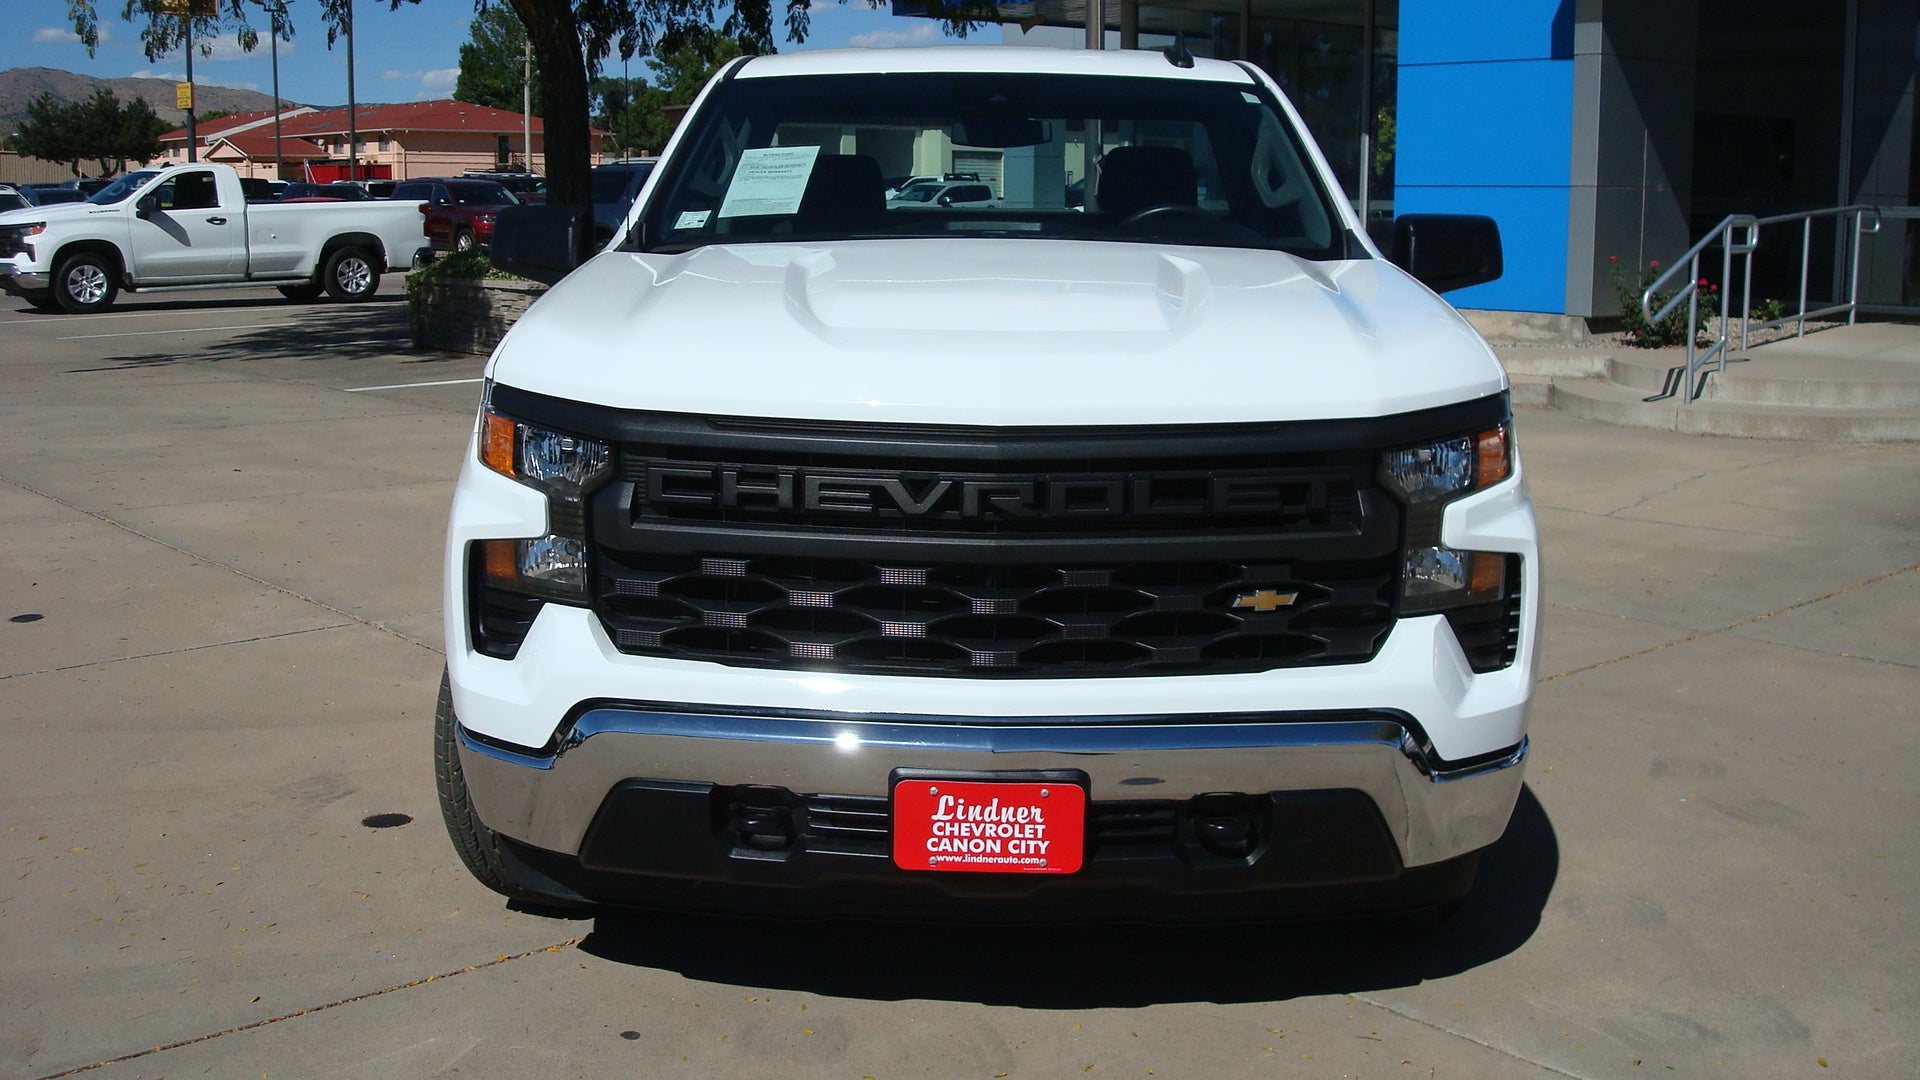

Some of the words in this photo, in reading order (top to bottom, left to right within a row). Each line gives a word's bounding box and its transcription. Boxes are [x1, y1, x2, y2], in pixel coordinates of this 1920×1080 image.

[646, 466, 1346, 518] CHEVROLET
[931, 794, 1044, 823] Lindner
[932, 822, 1046, 839] CHEVROLET
[926, 838, 1001, 854] CANON
[1008, 839, 1051, 855] CITY
[936, 853, 1039, 865] www.lindnerauto.com
